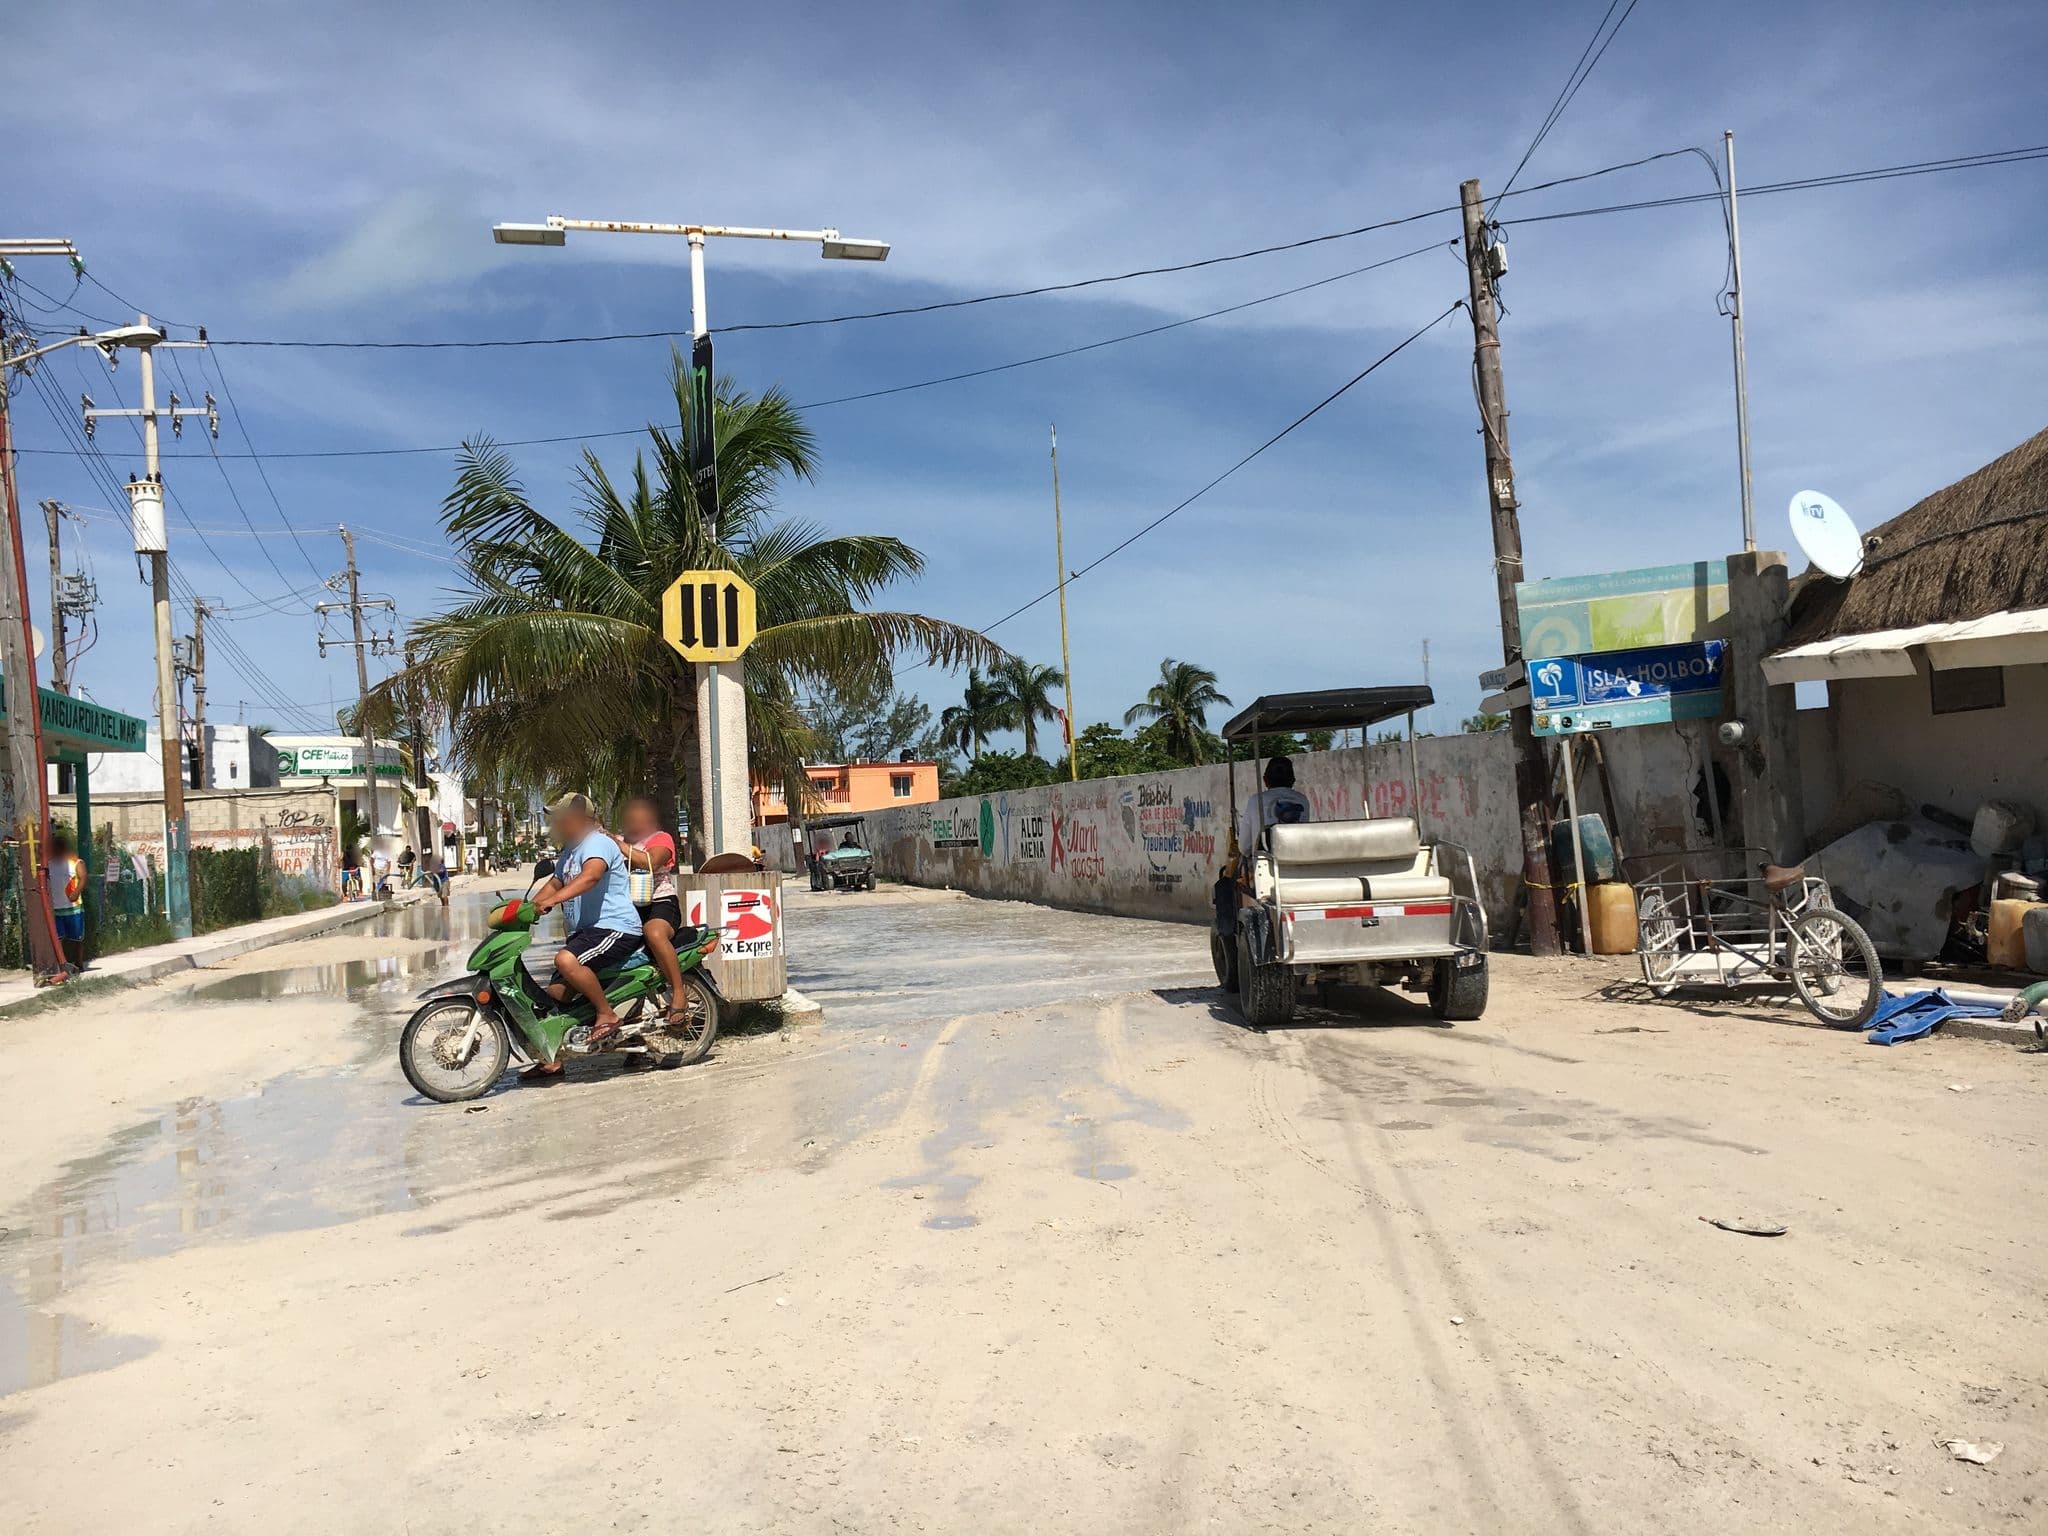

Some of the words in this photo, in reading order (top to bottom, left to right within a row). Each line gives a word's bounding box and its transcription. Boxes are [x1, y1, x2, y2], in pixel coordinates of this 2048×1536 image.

[1588, 667, 1629, 688] ISLA
[1637, 656, 1718, 682] HOLBOX
[40, 695, 100, 734] VANGUARDIA
[101, 712, 119, 740] DEL
[120, 719, 137, 744] MAR
[301, 749, 323, 760] CFE
[1020, 816, 1044, 839] ALDO
[1020, 840, 1046, 859] MENA
